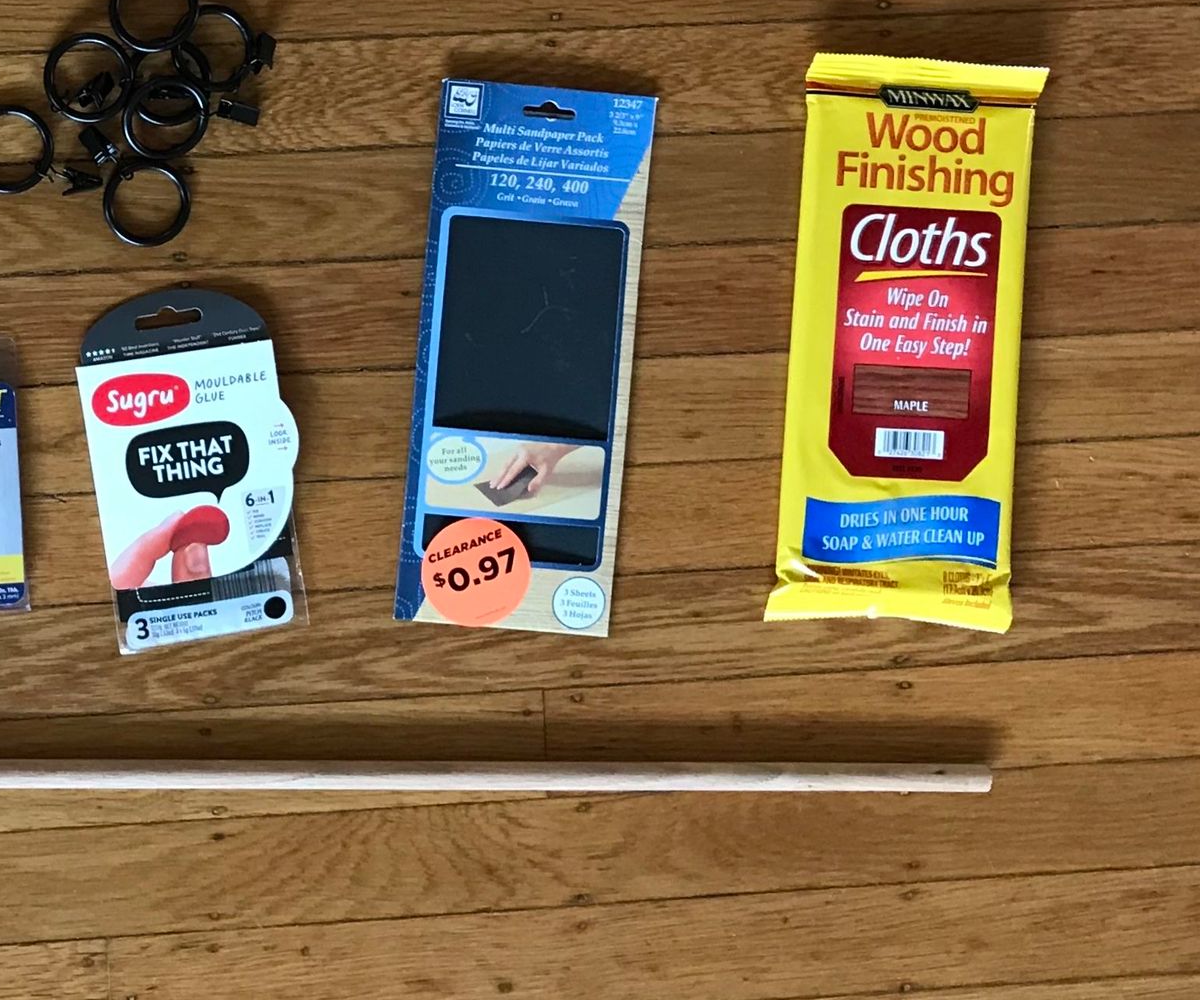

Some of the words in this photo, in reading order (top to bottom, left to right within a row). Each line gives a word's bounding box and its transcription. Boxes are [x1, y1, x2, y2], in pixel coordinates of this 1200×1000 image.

[613, 98, 643, 110] 12347
[886, 88, 971, 109] MINWAX
[483, 122, 515, 136] Multi
[516, 124, 575, 142] Sandpaper
[575, 130, 604, 144] Pack
[866, 111, 987, 155] Wood
[475, 136, 517, 152] Papiers
[518, 138, 532, 151] de
[534, 141, 563, 156] Verre
[563, 143, 609, 159] Assortis
[471, 151, 514, 166] Papeles
[516, 152, 529, 165] de
[530, 154, 559, 170] Lijar
[559, 158, 609, 173] Variados
[490, 172, 520, 190] 120,
[524, 175, 556, 193] 240,
[561, 179, 590, 195] 400
[835, 150, 1015, 208] Finishing
[496, 192, 515, 202] Grit
[849, 212, 993, 268] Cloths
[887, 286, 925, 311] Wipe
[927, 288, 949, 308] On
[843, 307, 885, 328] Stain
[888, 311, 921, 331] and
[922, 312, 968, 333] Finish
[971, 315, 988, 334] in
[859, 331, 891, 353] One
[894, 334, 928, 359] Easy
[929, 336, 971, 361] Step!
[194, 370, 268, 390] MOULDABLE
[106, 387, 174, 418] Sugru
[195, 390, 225, 405] GLUE
[893, 399, 929, 412] MAPLE
[268, 436, 291, 446] INSIDE
[270, 429, 288, 438] LOOK
[137, 443, 174, 466] FIX
[176, 434, 233, 460] THAT
[429, 456, 448, 466] your
[449, 454, 481, 465] sanding
[441, 447, 455, 455] For
[457, 446, 467, 454] all
[152, 456, 225, 483] THING
[444, 463, 468, 473] needs
[839, 511, 880, 529] DRIES
[883, 508, 897, 526] IN
[900, 506, 927, 523] ONE
[930, 505, 969, 522] HOUR
[428, 528, 503, 564] CLEARANCE
[822, 534, 859, 551] SOAP
[861, 536, 873, 550] &
[876, 530, 920, 548] WATER
[923, 528, 965, 545] CLEAN
[967, 530, 985, 547] UP
[432, 546, 516, 592] $0.97
[560, 598, 566, 606] 3
[566, 599, 598, 610] Feuilles
[564, 588, 569, 596] 3
[569, 588, 597, 599] Sheets
[134, 617, 150, 640] 3
[150, 613, 176, 624] SINGLE
[177, 612, 193, 621] USE
[193, 608, 218, 619] PACKS
[563, 609, 568, 617] 3
[568, 610, 593, 621] Hojas
